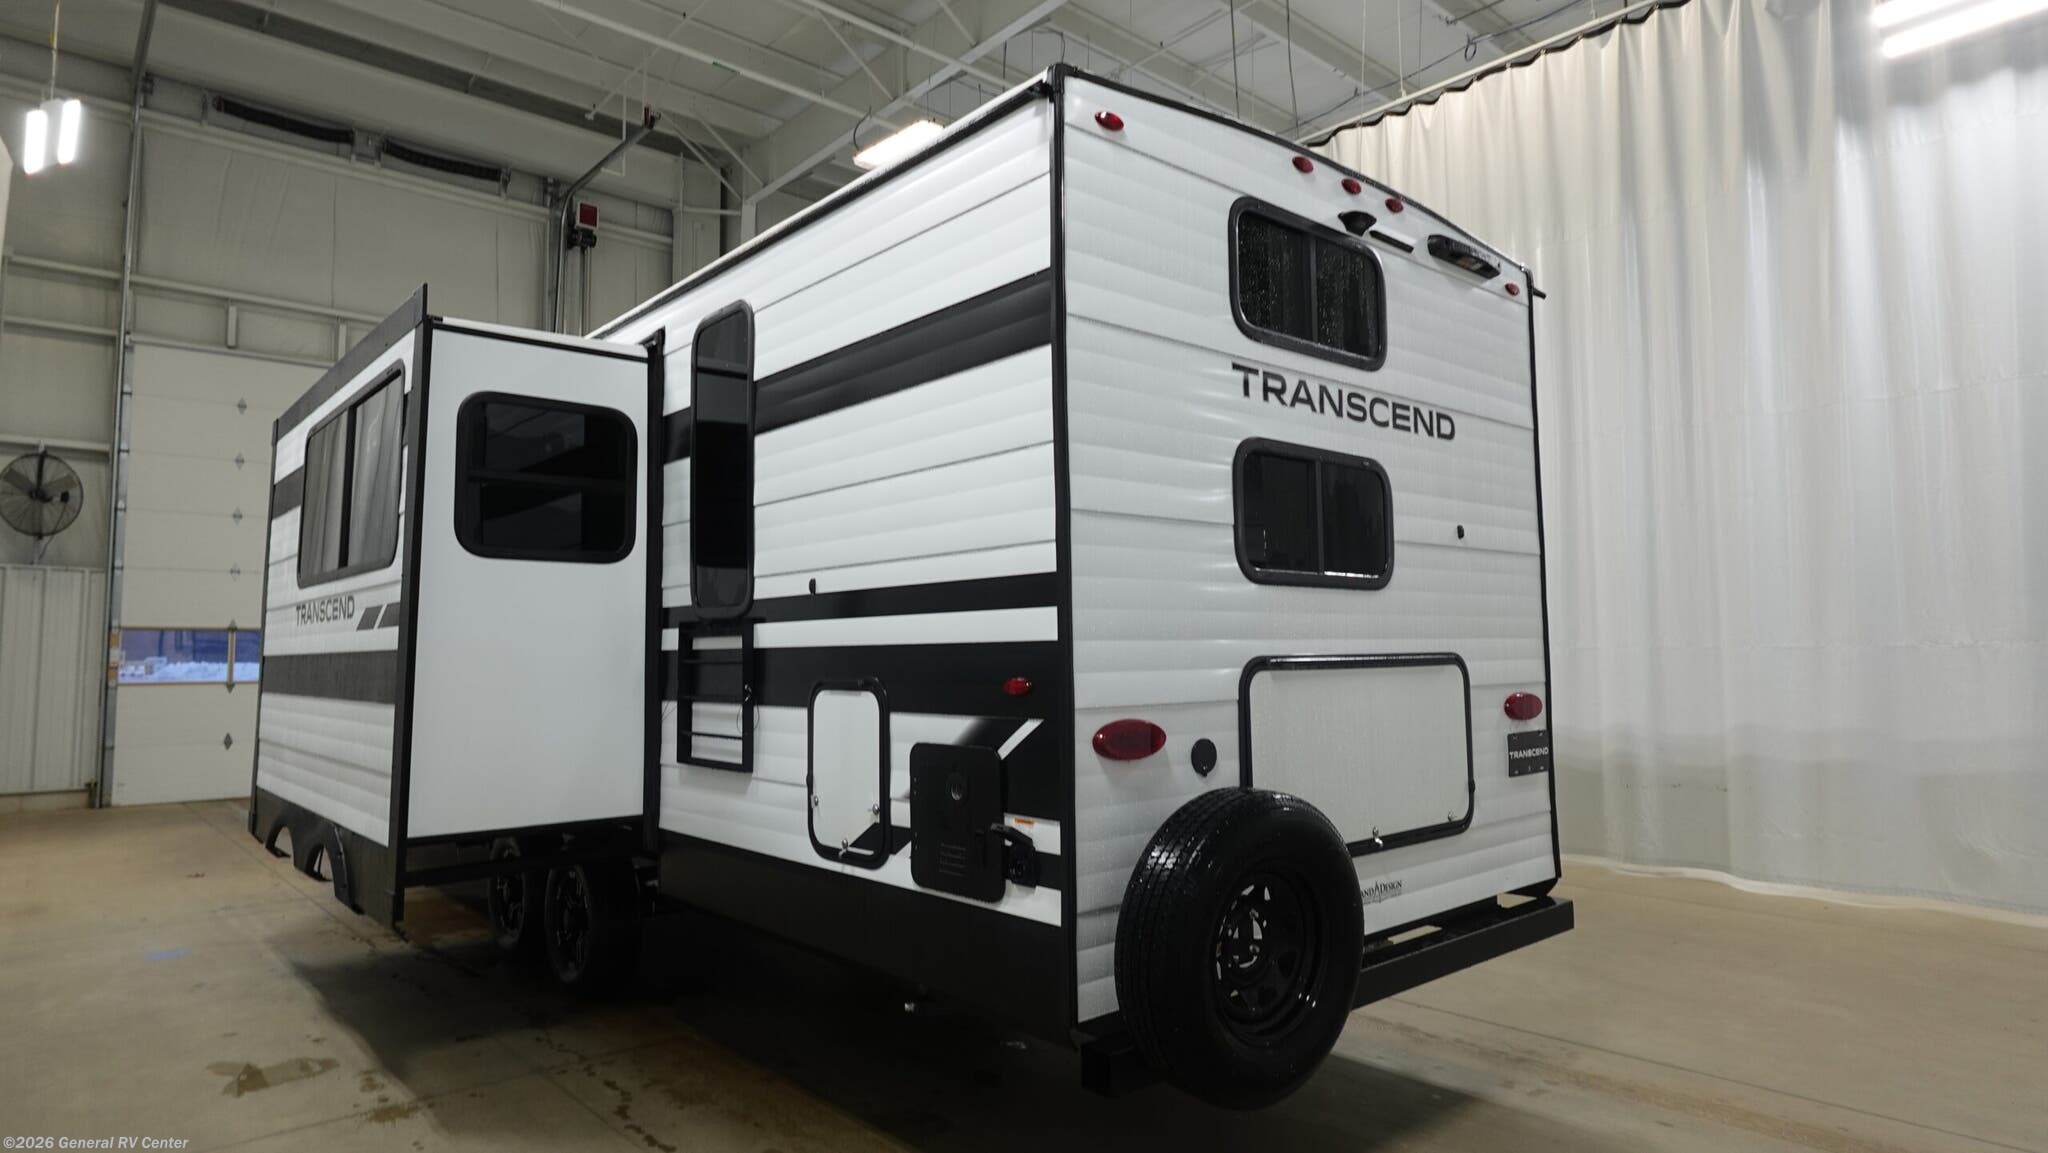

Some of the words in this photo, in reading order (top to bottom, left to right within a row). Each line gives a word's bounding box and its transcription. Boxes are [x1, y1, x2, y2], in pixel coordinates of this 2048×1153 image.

[1231, 362, 1456, 441] TRANSCEND
[296, 594, 355, 626] TRANSCEND
[1509, 746, 1549, 760] TRANSCEND
